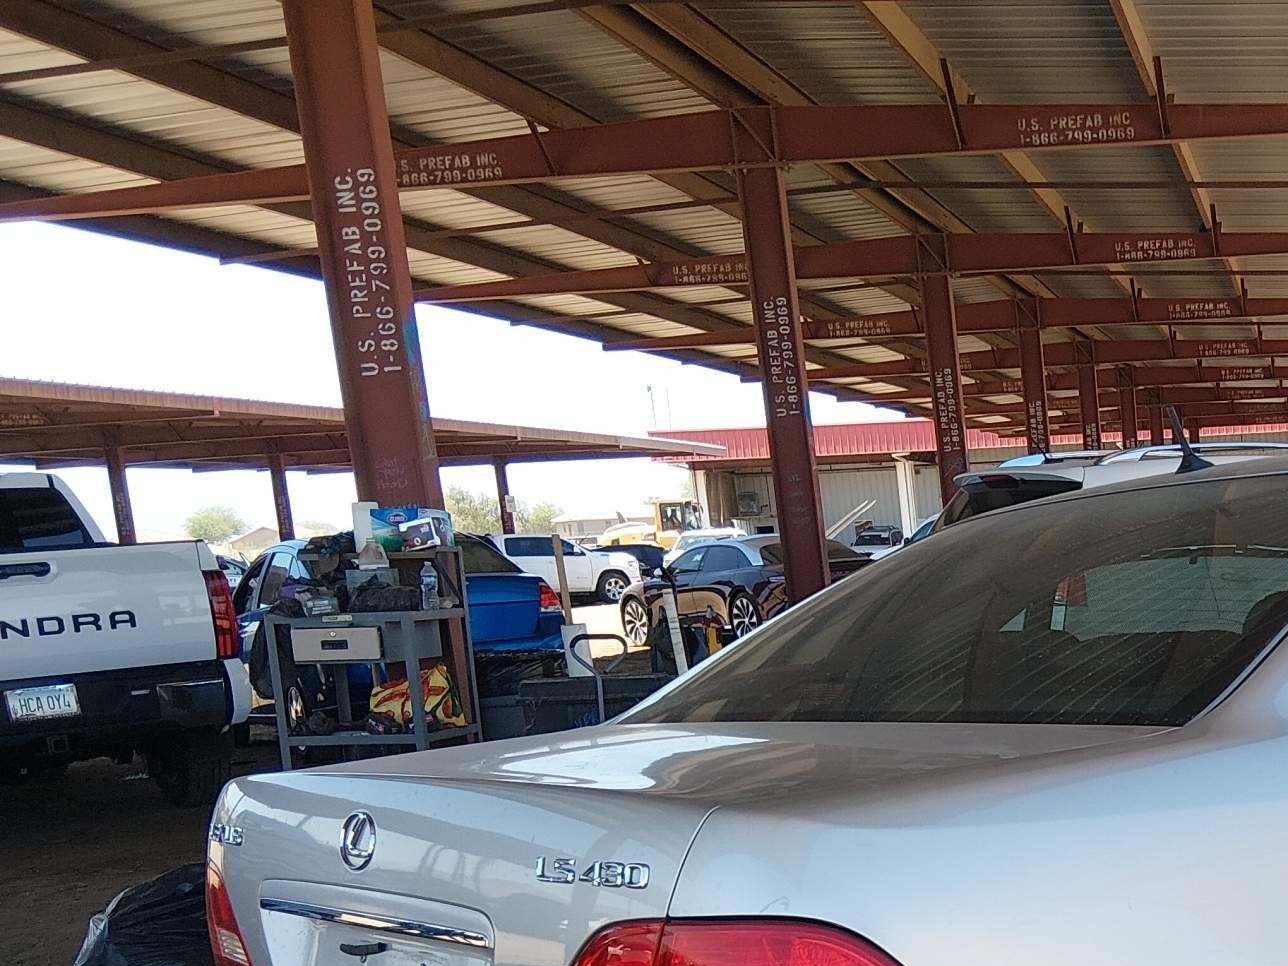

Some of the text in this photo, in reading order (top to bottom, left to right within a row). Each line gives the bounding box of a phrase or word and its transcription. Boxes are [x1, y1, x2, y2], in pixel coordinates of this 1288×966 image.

[1018, 118, 1043, 132] U.S.
[1050, 114, 1102, 130] PREFAB
[1020, 127, 1135, 145] 1-866-799-0969
[419, 154, 471, 171] PREFAB
[476, 152, 502, 167] INC.
[397, 166, 503, 185] -866-799-0969
[1114, 241, 1134, 251] U.S.
[1137, 239, 1174, 250] PREFAB
[334, 168, 380, 376] U.S. PREFAB INC.
[356, 168, 402, 373] 1-866-799-0969
[672, 264, 692, 275] U.S.
[694, 263, 731, 273] PREFAB
[763, 296, 788, 417] U.S. PREFAB INC.
[777, 297, 801, 415] 1-866-799-0969
[937, 391, 950, 430] PREFAB
